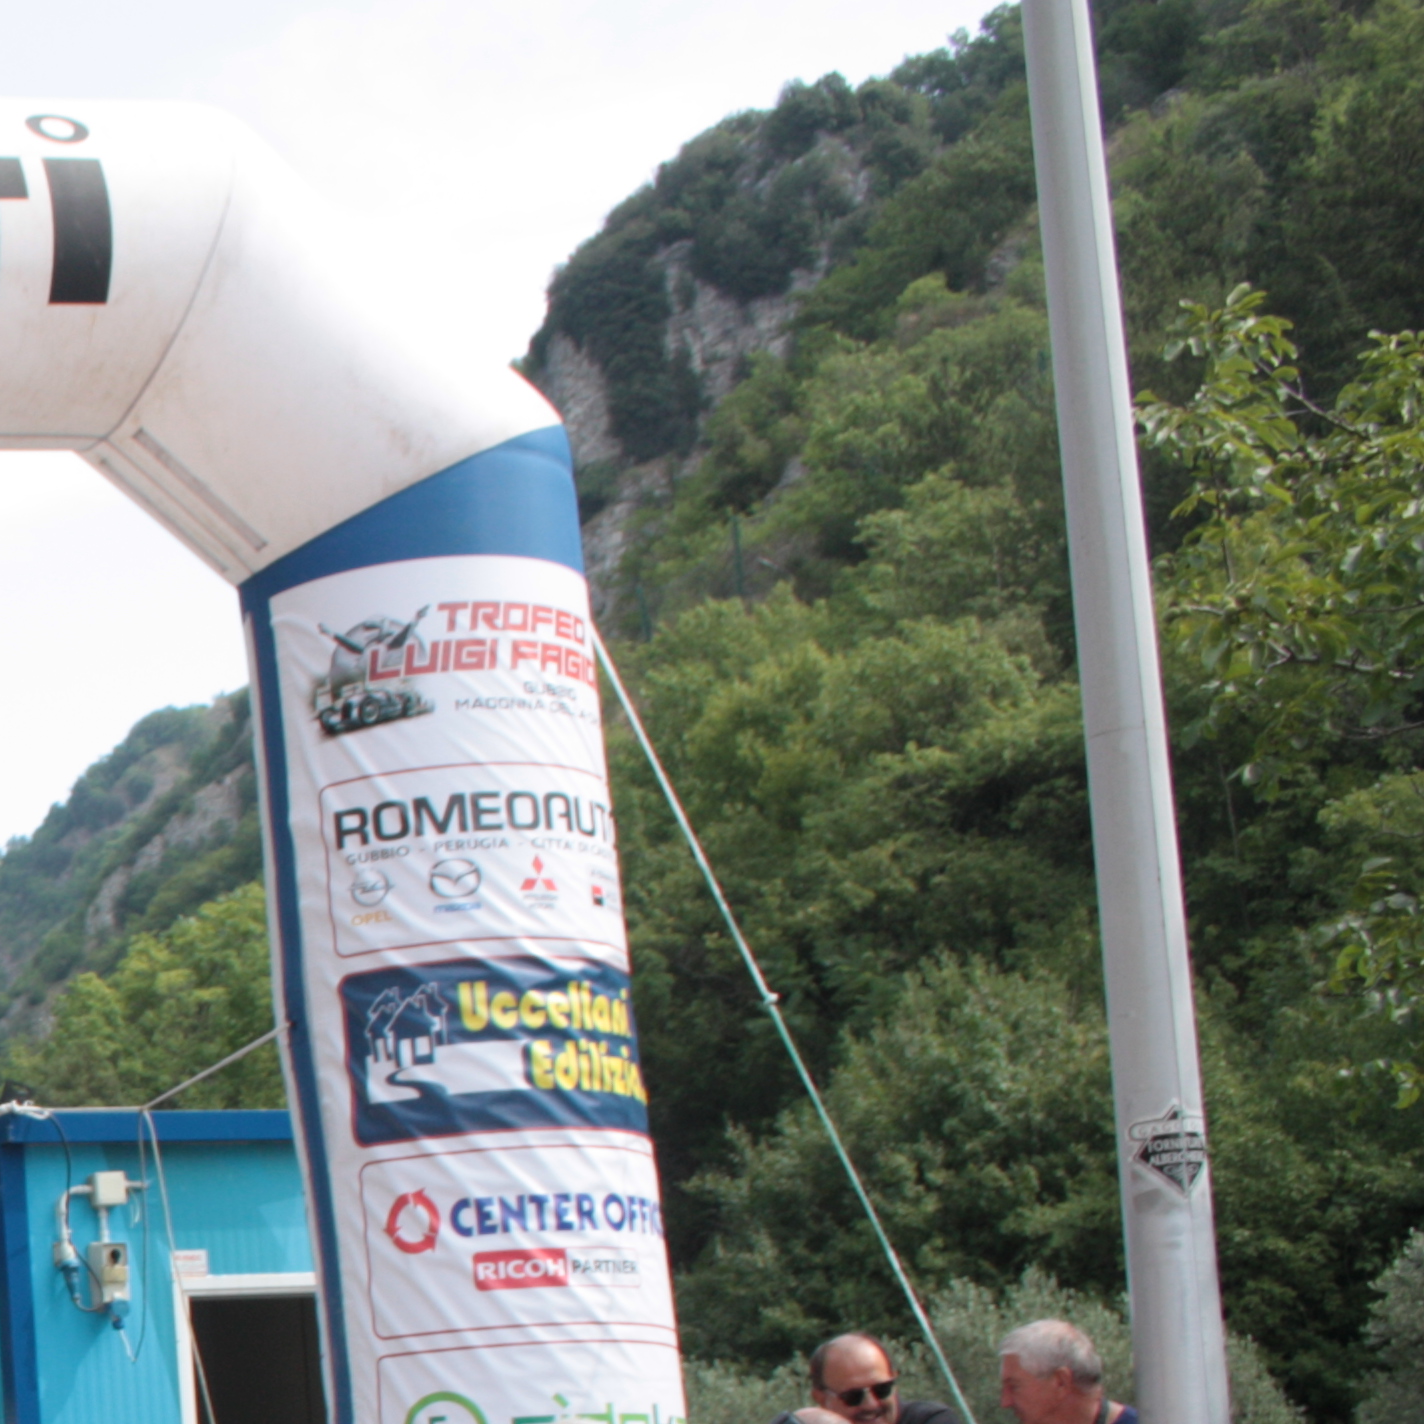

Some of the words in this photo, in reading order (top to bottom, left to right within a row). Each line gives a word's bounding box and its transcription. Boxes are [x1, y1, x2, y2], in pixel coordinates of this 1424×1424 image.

[437, 601, 585, 646] TROFEO
[367, 638, 498, 681] LUIGI
[334, 791, 613, 850] ROMEOAUT
[346, 845, 409, 866] GUBBIO
[434, 838, 508, 852] PERUGIA
[352, 910, 393, 927] OPEL
[450, 1193, 598, 1237] CENTER
[476, 1258, 566, 1281] RICOH
[571, 1259, 638, 1274] PARTNER
